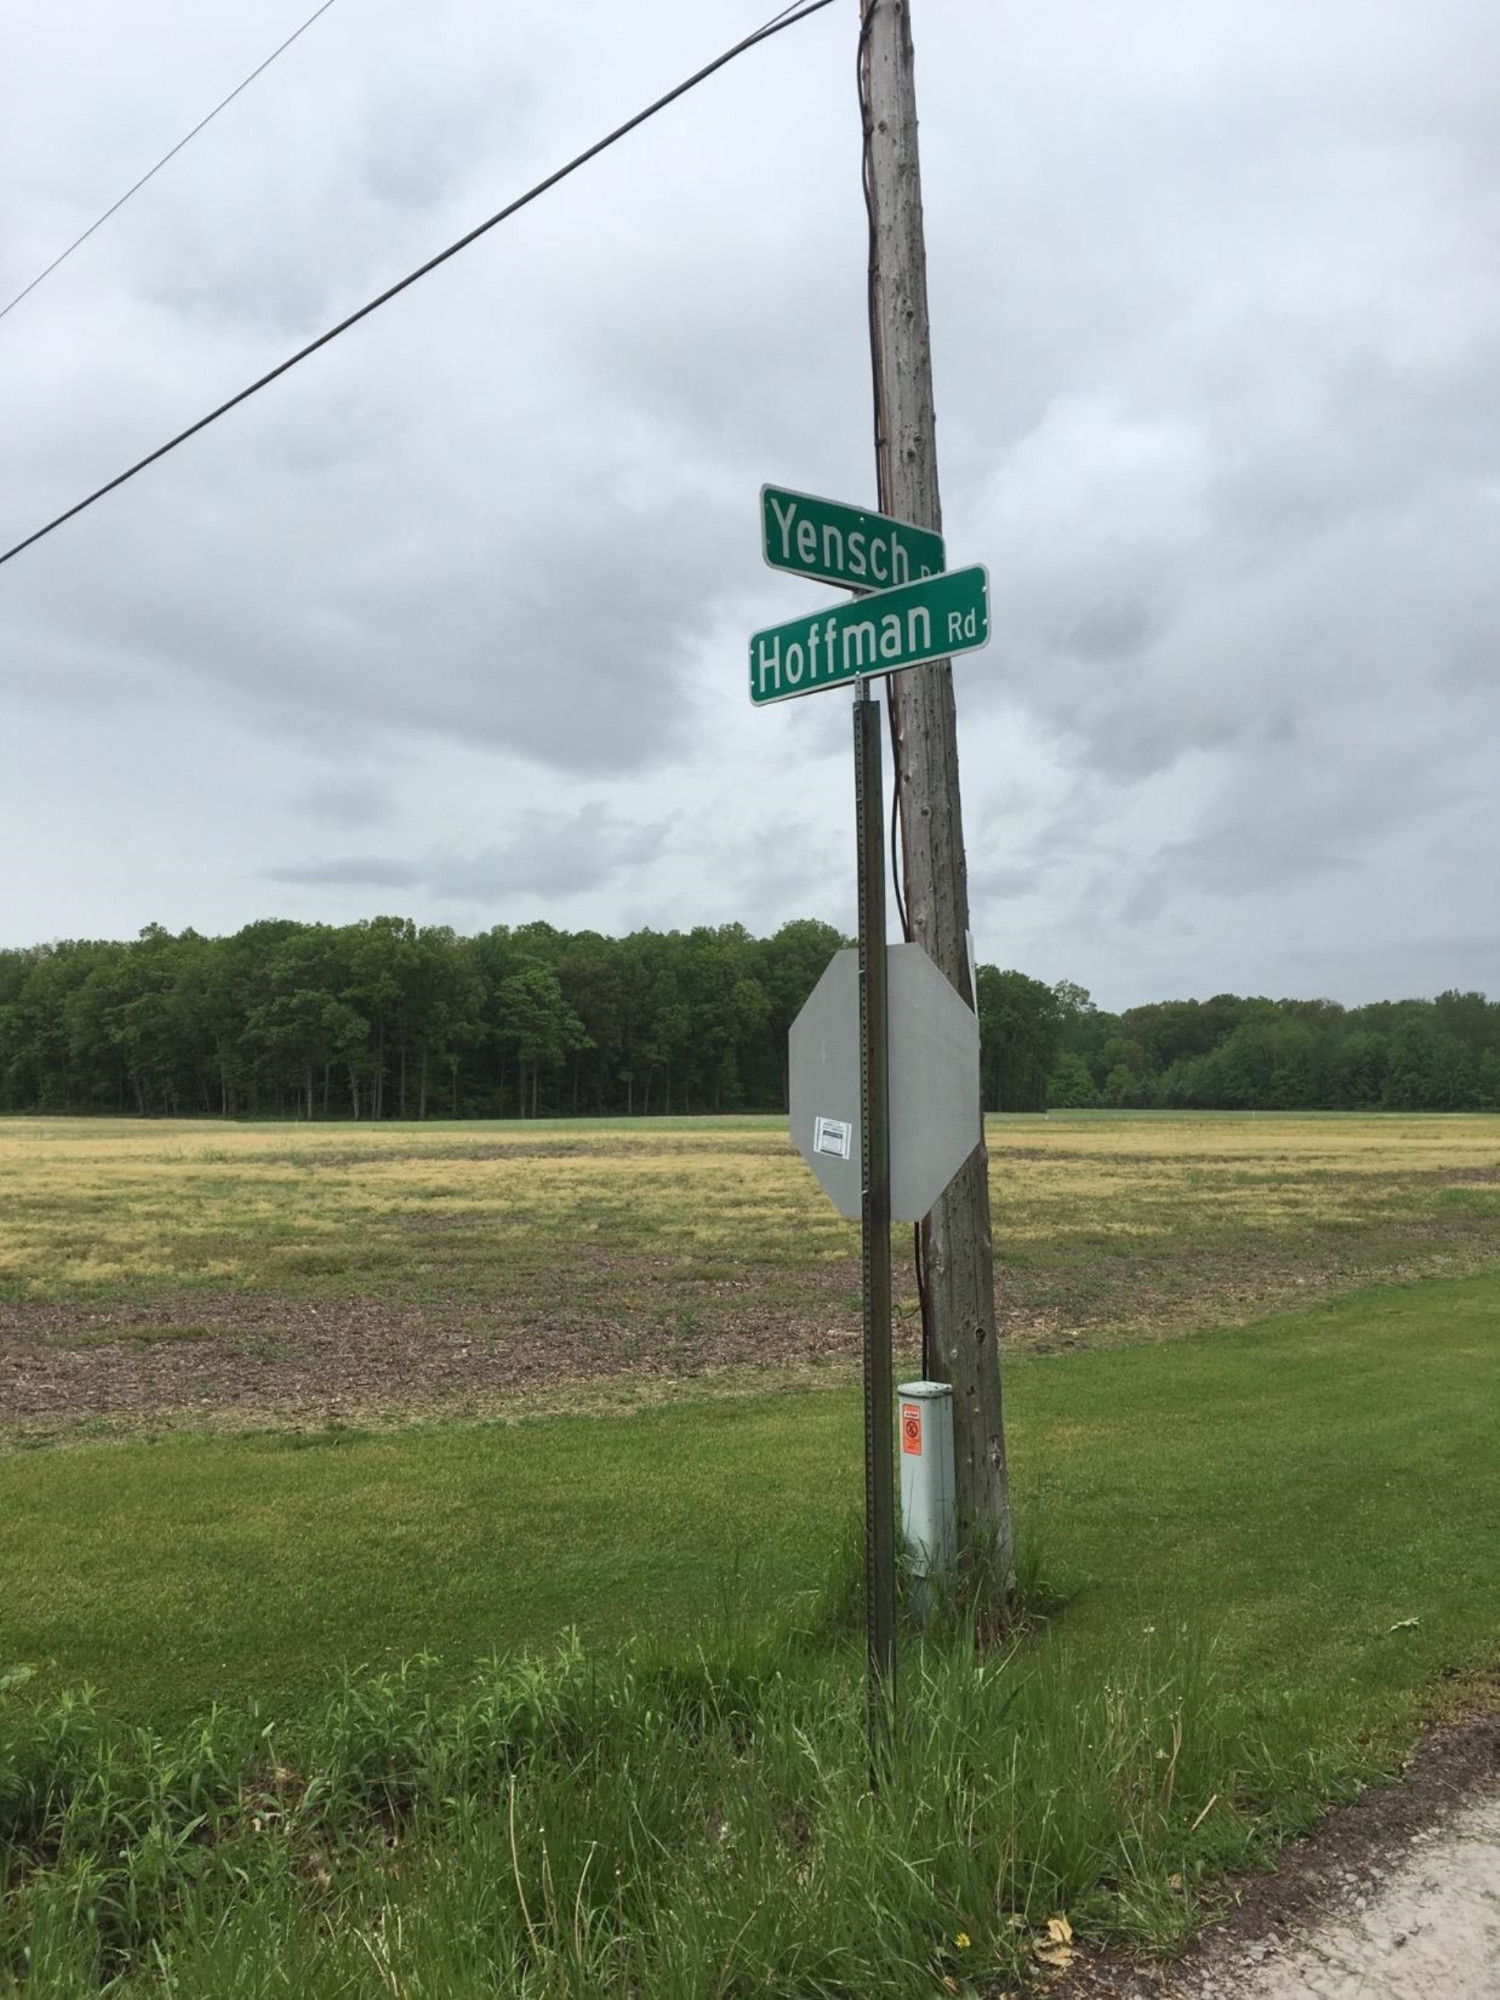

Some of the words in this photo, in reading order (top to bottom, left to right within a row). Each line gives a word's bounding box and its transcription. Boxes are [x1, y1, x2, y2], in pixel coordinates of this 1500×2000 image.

[770, 498, 909, 585] Yensch
[759, 606, 931, 693] Hoffman
[948, 607, 976, 643] Rd
